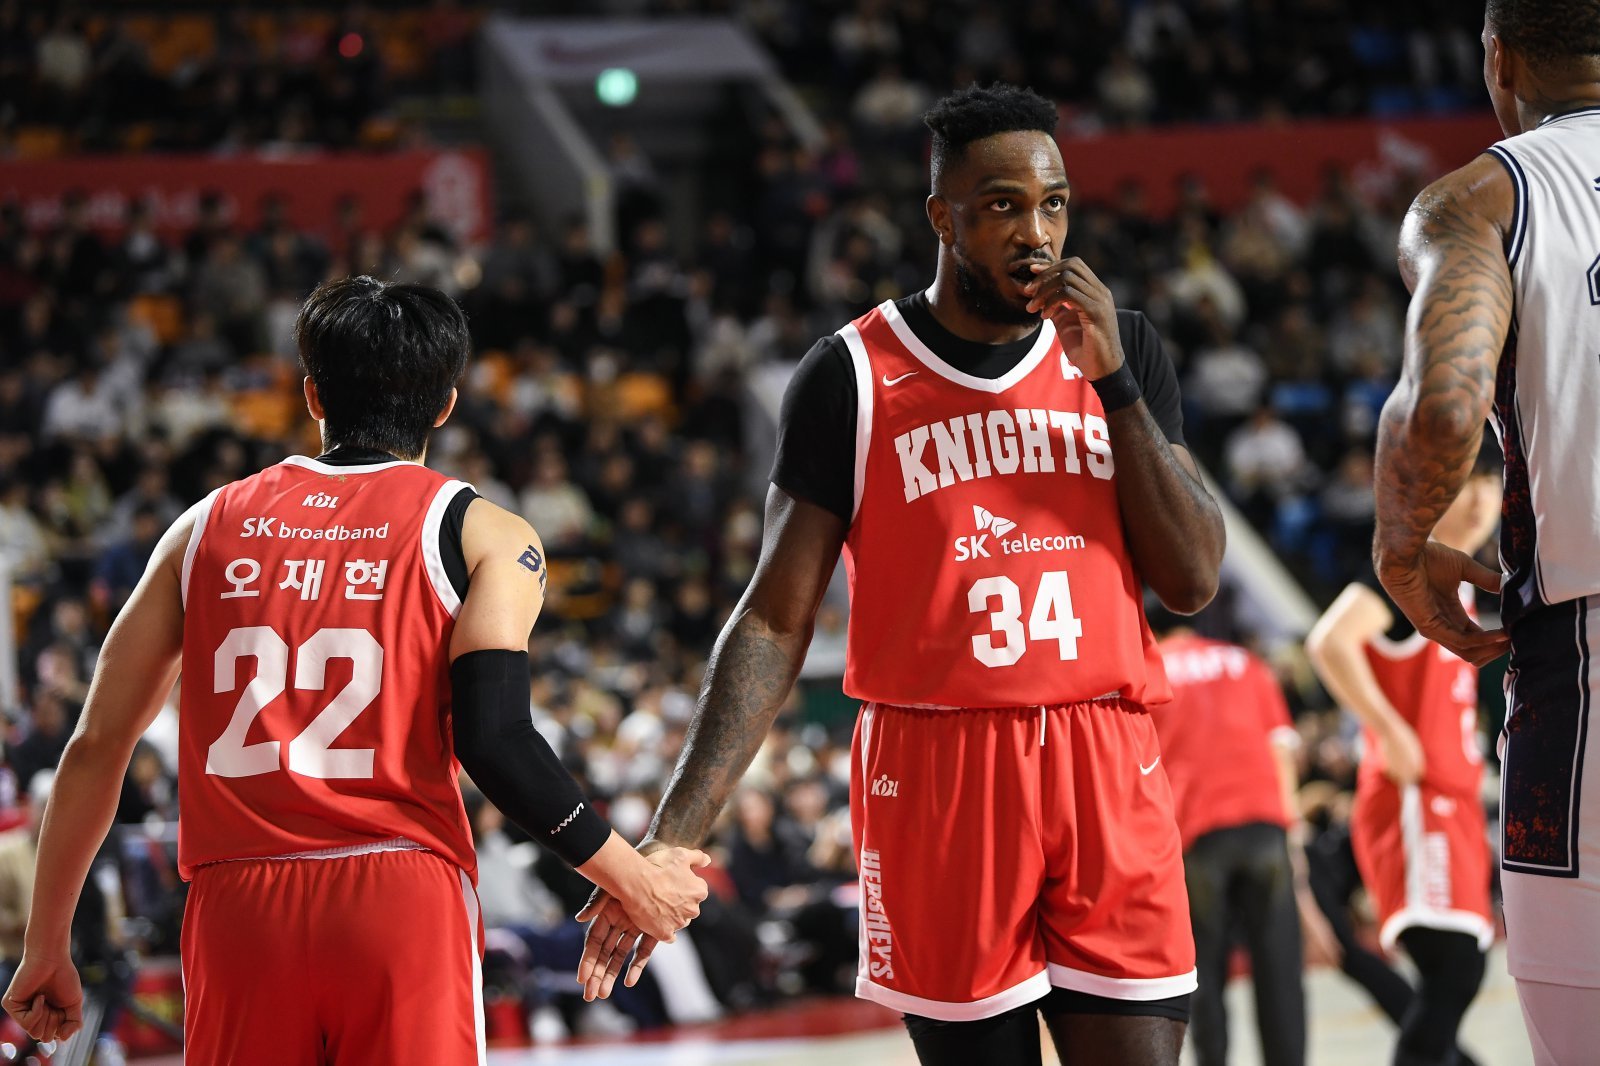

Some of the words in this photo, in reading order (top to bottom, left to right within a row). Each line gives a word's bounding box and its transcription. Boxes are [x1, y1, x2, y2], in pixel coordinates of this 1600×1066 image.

[894, 408, 1115, 504] KNIGHTS
[240, 517, 277, 538] SK
[278, 522, 390, 541] broadband
[302, 491, 339, 509] KBL
[954, 533, 991, 562] SK
[1000, 532, 1086, 555] telecom
[967, 570, 1083, 668] 34
[205, 625, 385, 779] 22
[870, 773, 899, 797] KBL
[862, 850, 895, 981] HERSHEY'S
